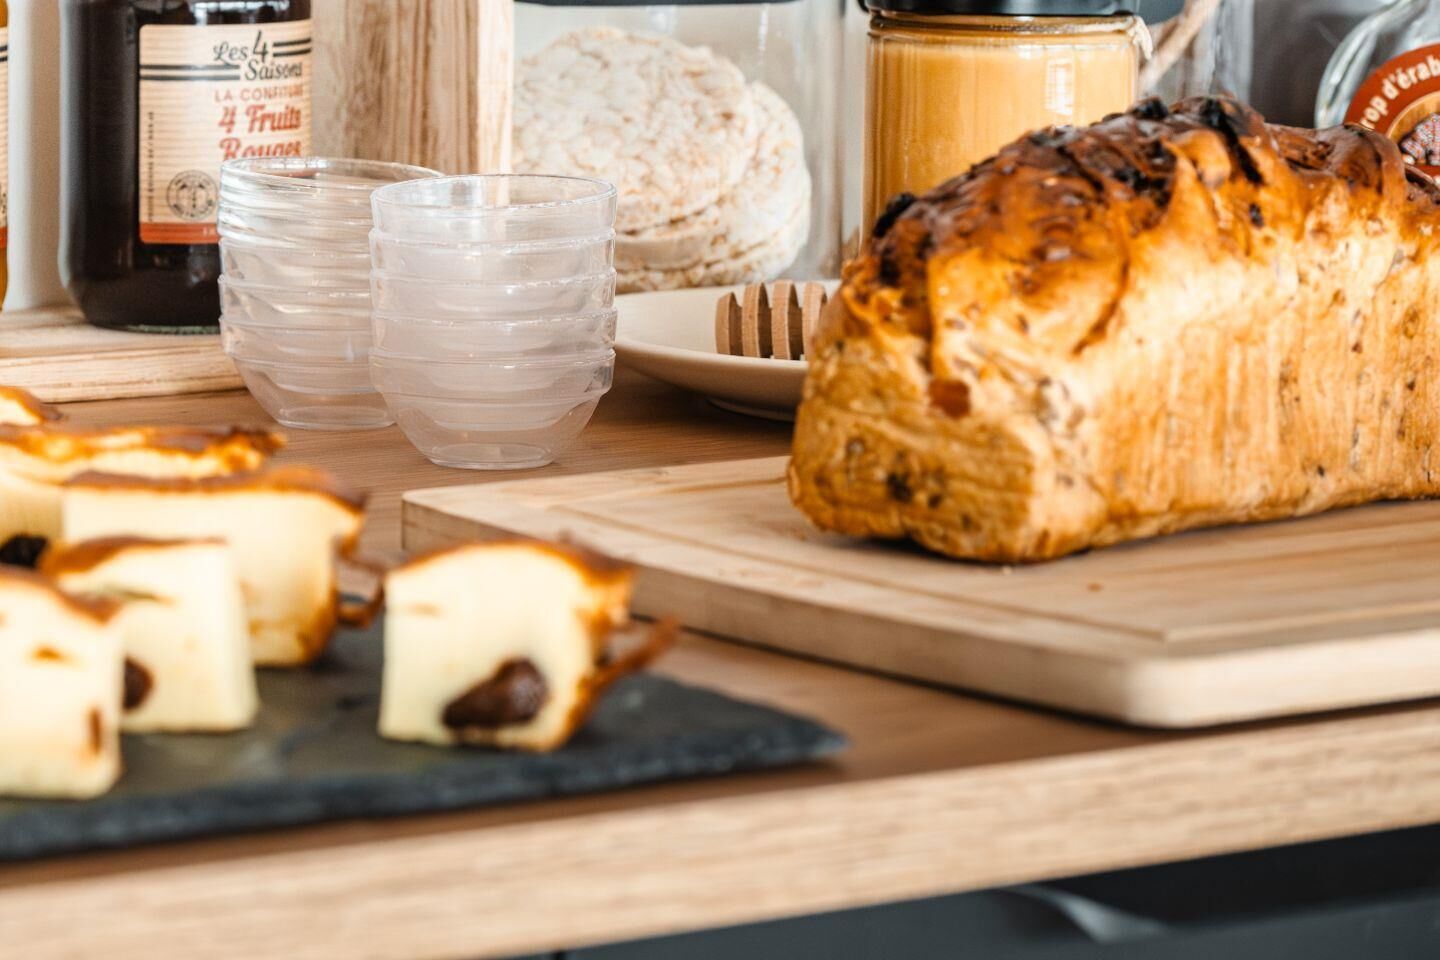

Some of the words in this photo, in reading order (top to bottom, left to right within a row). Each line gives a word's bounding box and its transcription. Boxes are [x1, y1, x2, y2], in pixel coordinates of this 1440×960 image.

[212, 40, 248, 66] Les
[252, 29, 270, 63] 4
[244, 58, 303, 82] Saisons
[214, 90, 234, 103] LA
[218, 105, 238, 134] 4
[244, 104, 302, 133] Fruits
